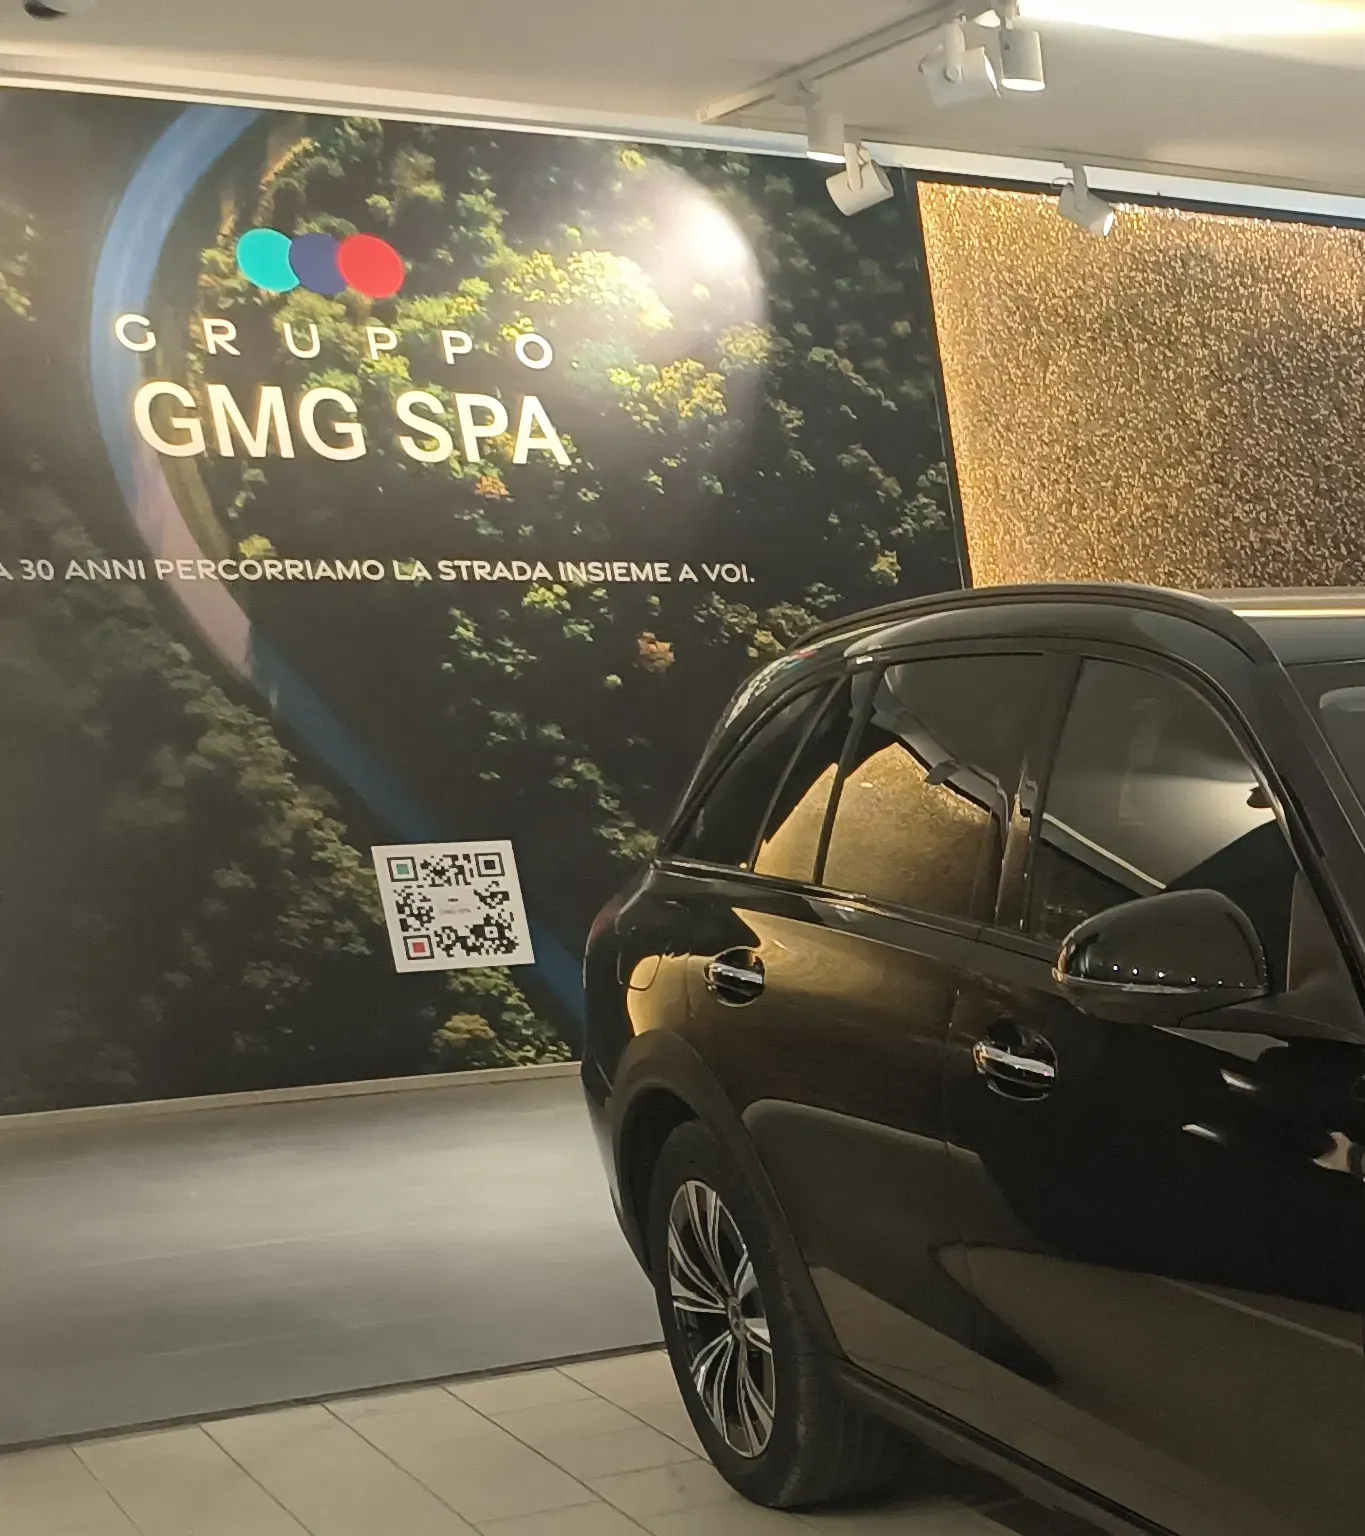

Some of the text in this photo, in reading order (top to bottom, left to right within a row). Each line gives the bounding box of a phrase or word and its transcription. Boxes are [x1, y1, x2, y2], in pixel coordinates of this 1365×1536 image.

[115, 313, 553, 369] GRUPPO
[133, 380, 572, 466] GMG SPA
[19, 558, 55, 581] 30
[64, 559, 146, 581] ANNI
[154, 559, 385, 582] PERCORRIAMO
[392, 560, 432, 581] LA
[437, 560, 553, 582] STRADA
[559, 561, 672, 583] INSIEME
[678, 563, 699, 583] A
[702, 563, 755, 584] VOI.
